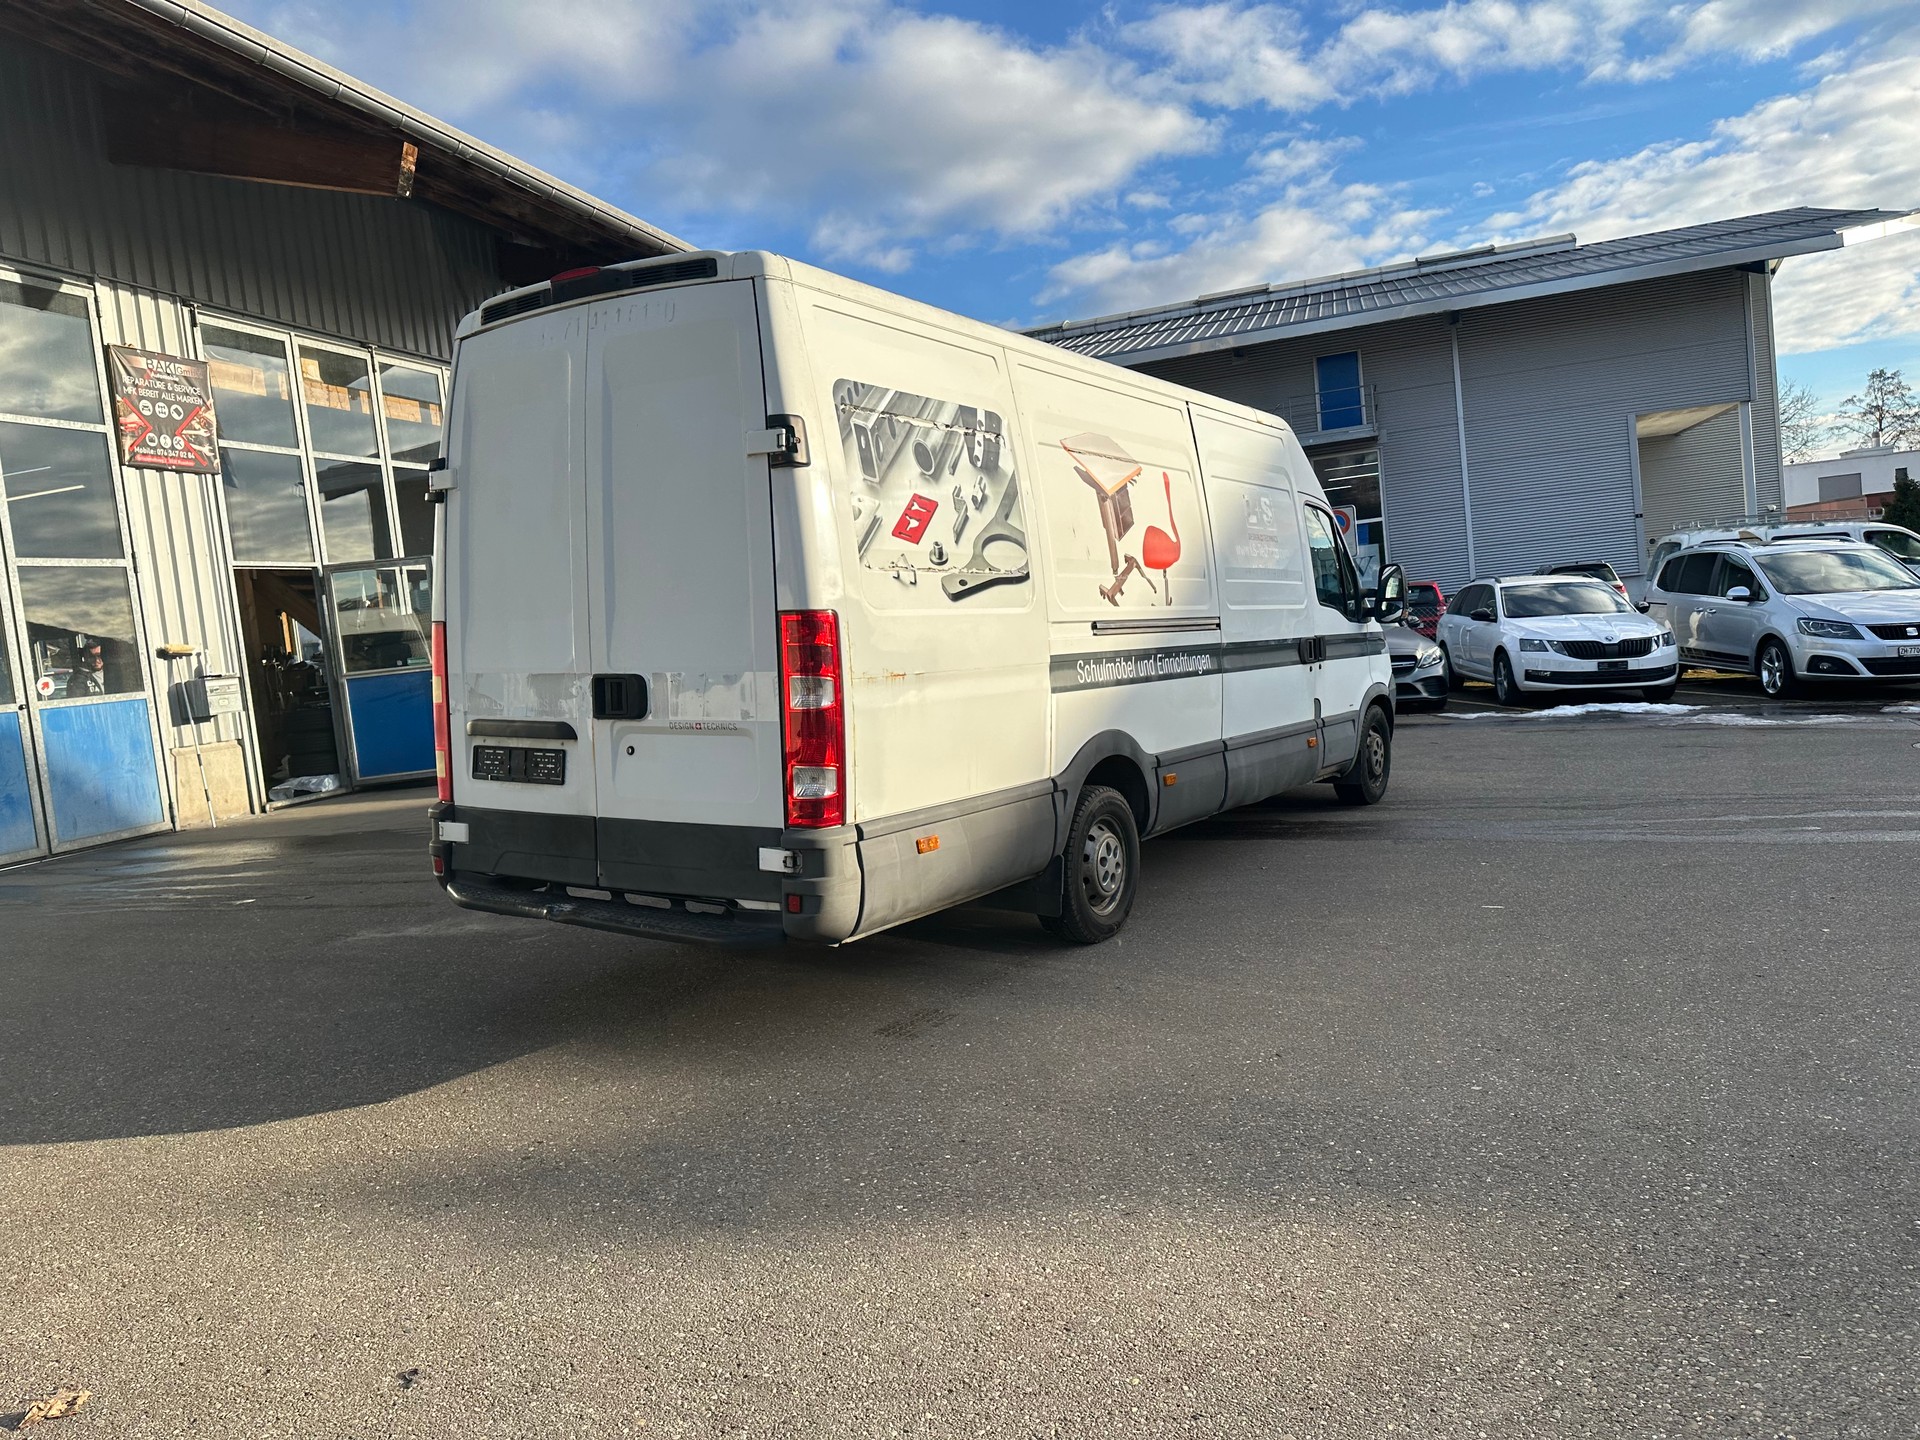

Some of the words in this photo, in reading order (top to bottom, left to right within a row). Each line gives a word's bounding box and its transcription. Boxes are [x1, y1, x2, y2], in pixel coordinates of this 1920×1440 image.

[146, 358, 176, 374] BAKI
[122, 375, 166, 390] REPARATURE
[174, 384, 201, 396] SERVICE
[123, 386, 138, 395] MFK
[138, 388, 159, 398] BEREIT
[161, 391, 176, 401] ALLE
[176, 394, 203, 405] MARKEN
[1077, 656, 1136, 684] Schulmöbel
[1137, 654, 1155, 676] und
[1156, 652, 1212, 674] Einrichtungen
[669, 721, 694, 730] DESIGN
[703, 722, 738, 731] TECHNICS
